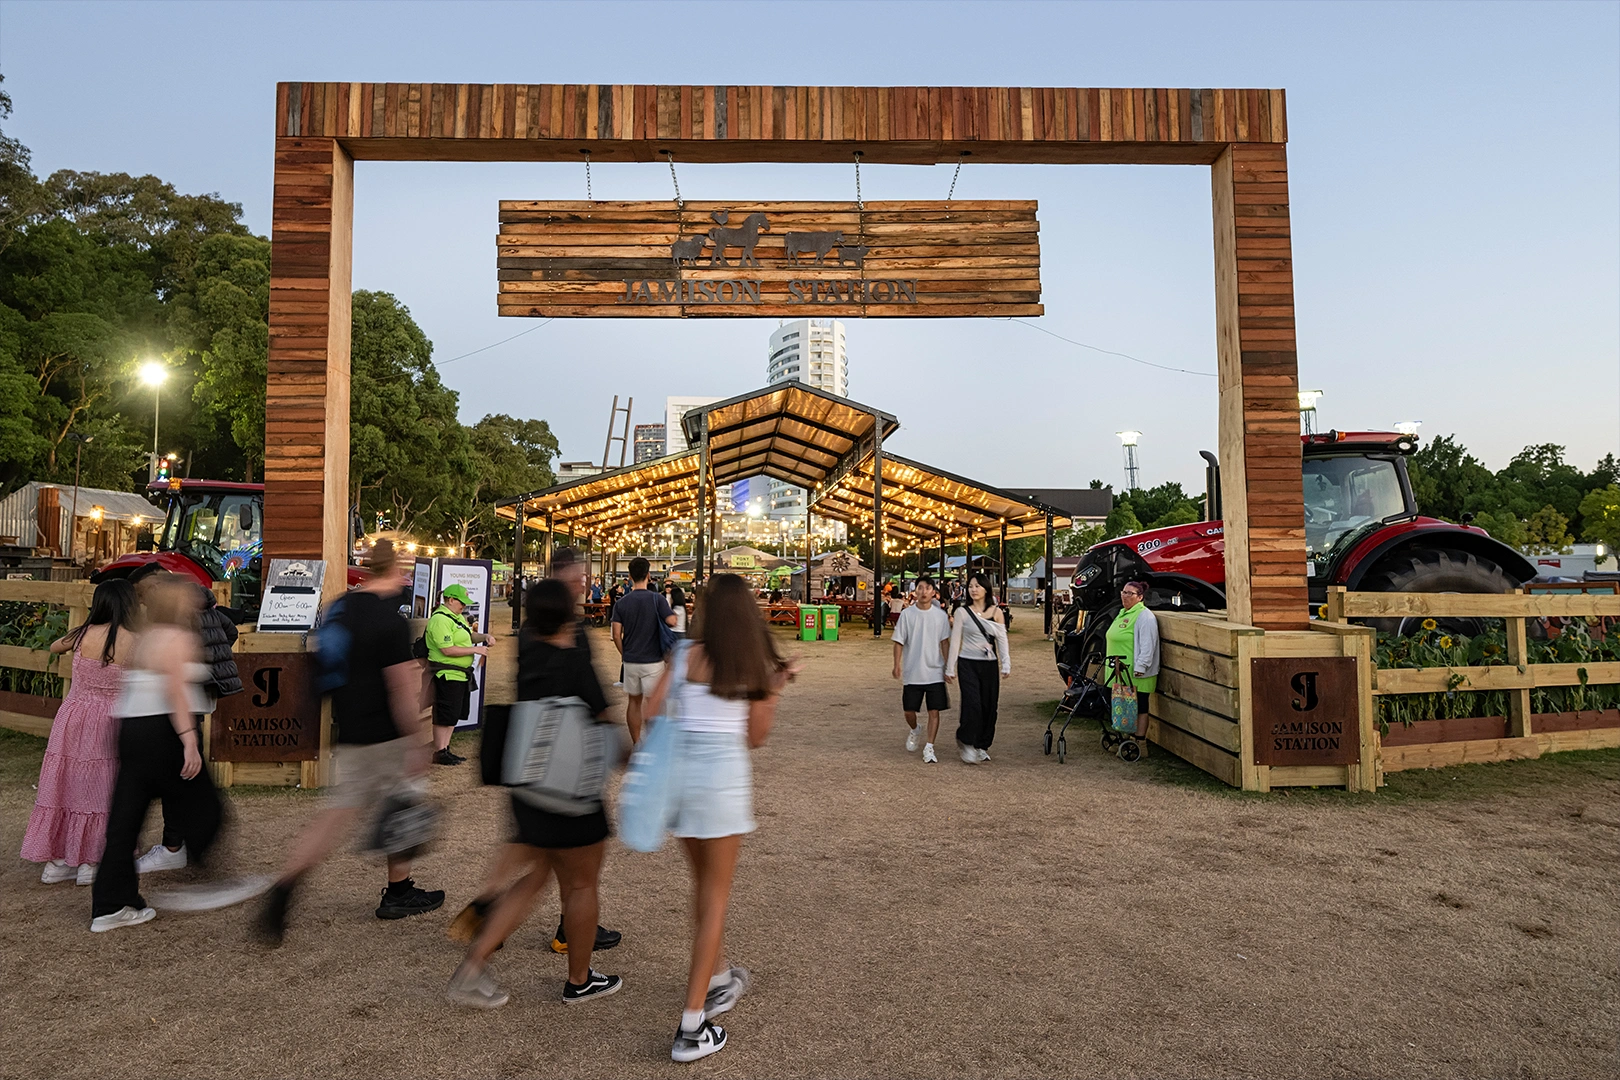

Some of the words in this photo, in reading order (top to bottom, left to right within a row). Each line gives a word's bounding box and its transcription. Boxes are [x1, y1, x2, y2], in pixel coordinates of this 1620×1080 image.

[616, 279, 763, 304] JAMISON
[787, 279, 919, 304] STATION
[1138, 539, 1161, 552] 300
[280, 594, 295, 602] Open
[229, 717, 302, 731] JAMISON
[1271, 721, 1343, 735] JAMISON
[231, 733, 299, 746] STATION
[1274, 738, 1340, 750] STATION
